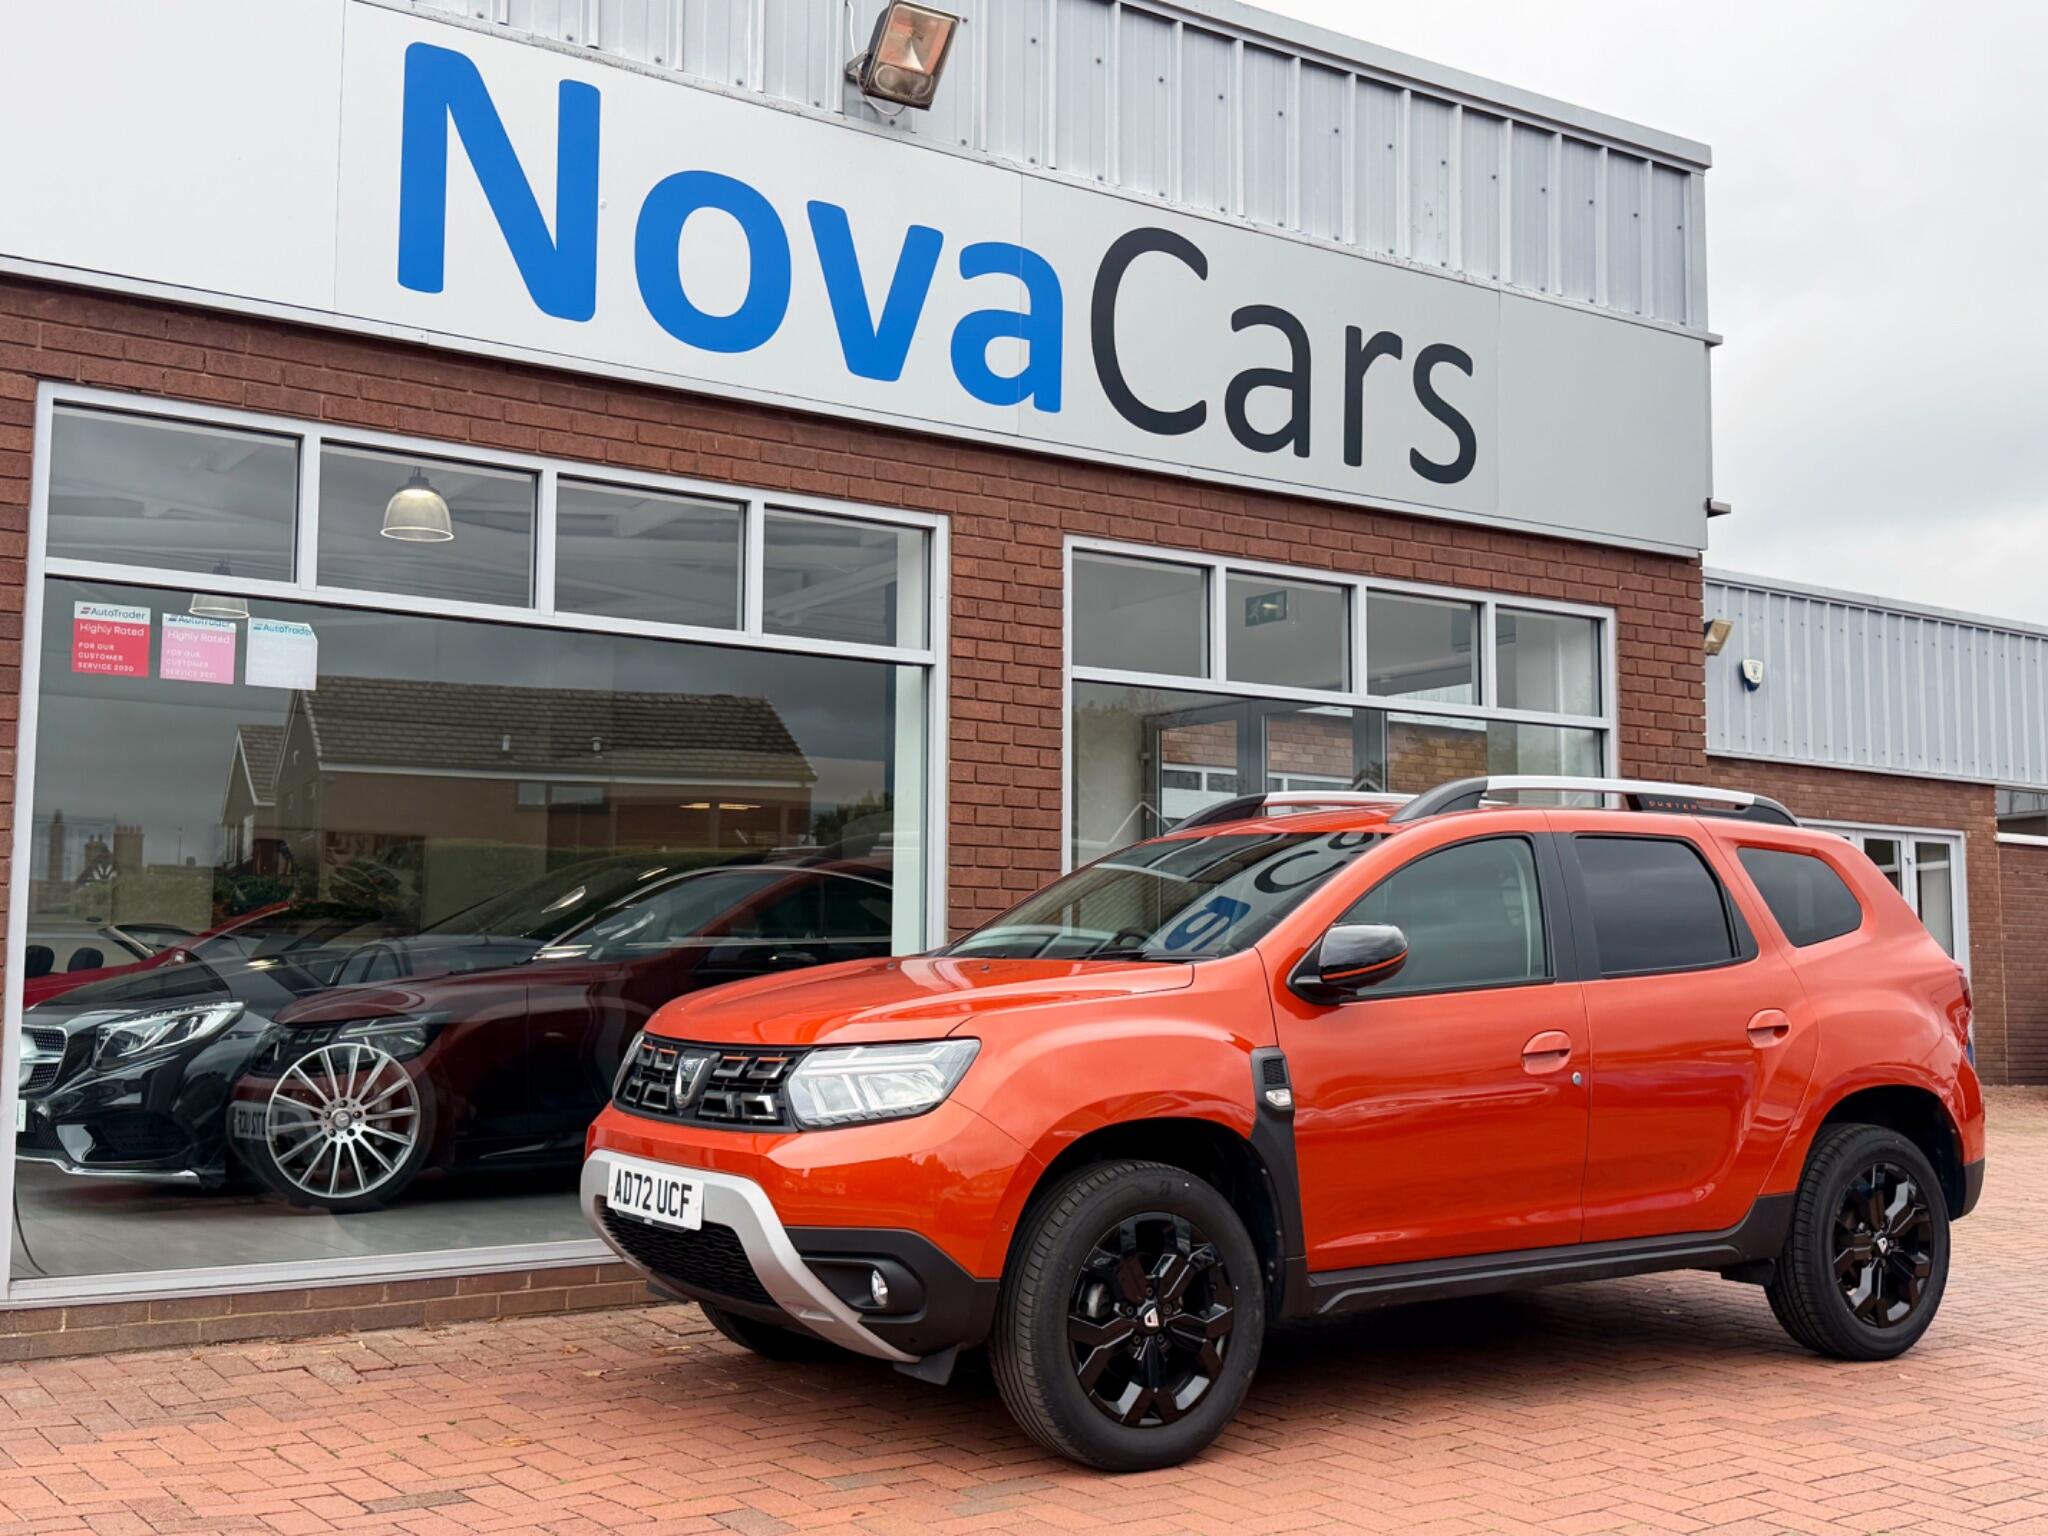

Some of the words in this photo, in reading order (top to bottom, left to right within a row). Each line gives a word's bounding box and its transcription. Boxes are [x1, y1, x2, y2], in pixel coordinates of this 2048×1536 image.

[90, 607, 145, 620] AutoTrader
[79, 623, 112, 635] Highly
[114, 626, 144, 637] Rated
[167, 630, 199, 642] Highly
[200, 632, 231, 644] Rated
[78, 641, 95, 649] FOR
[97, 643, 114, 651] OUR
[78, 651, 123, 661] CUSTOMER
[77, 662, 112, 671] SERVICE
[1648, 801, 1697, 810] DUSTER
[614, 1168, 653, 1211] AD72
[657, 1178, 692, 1219] UCF
